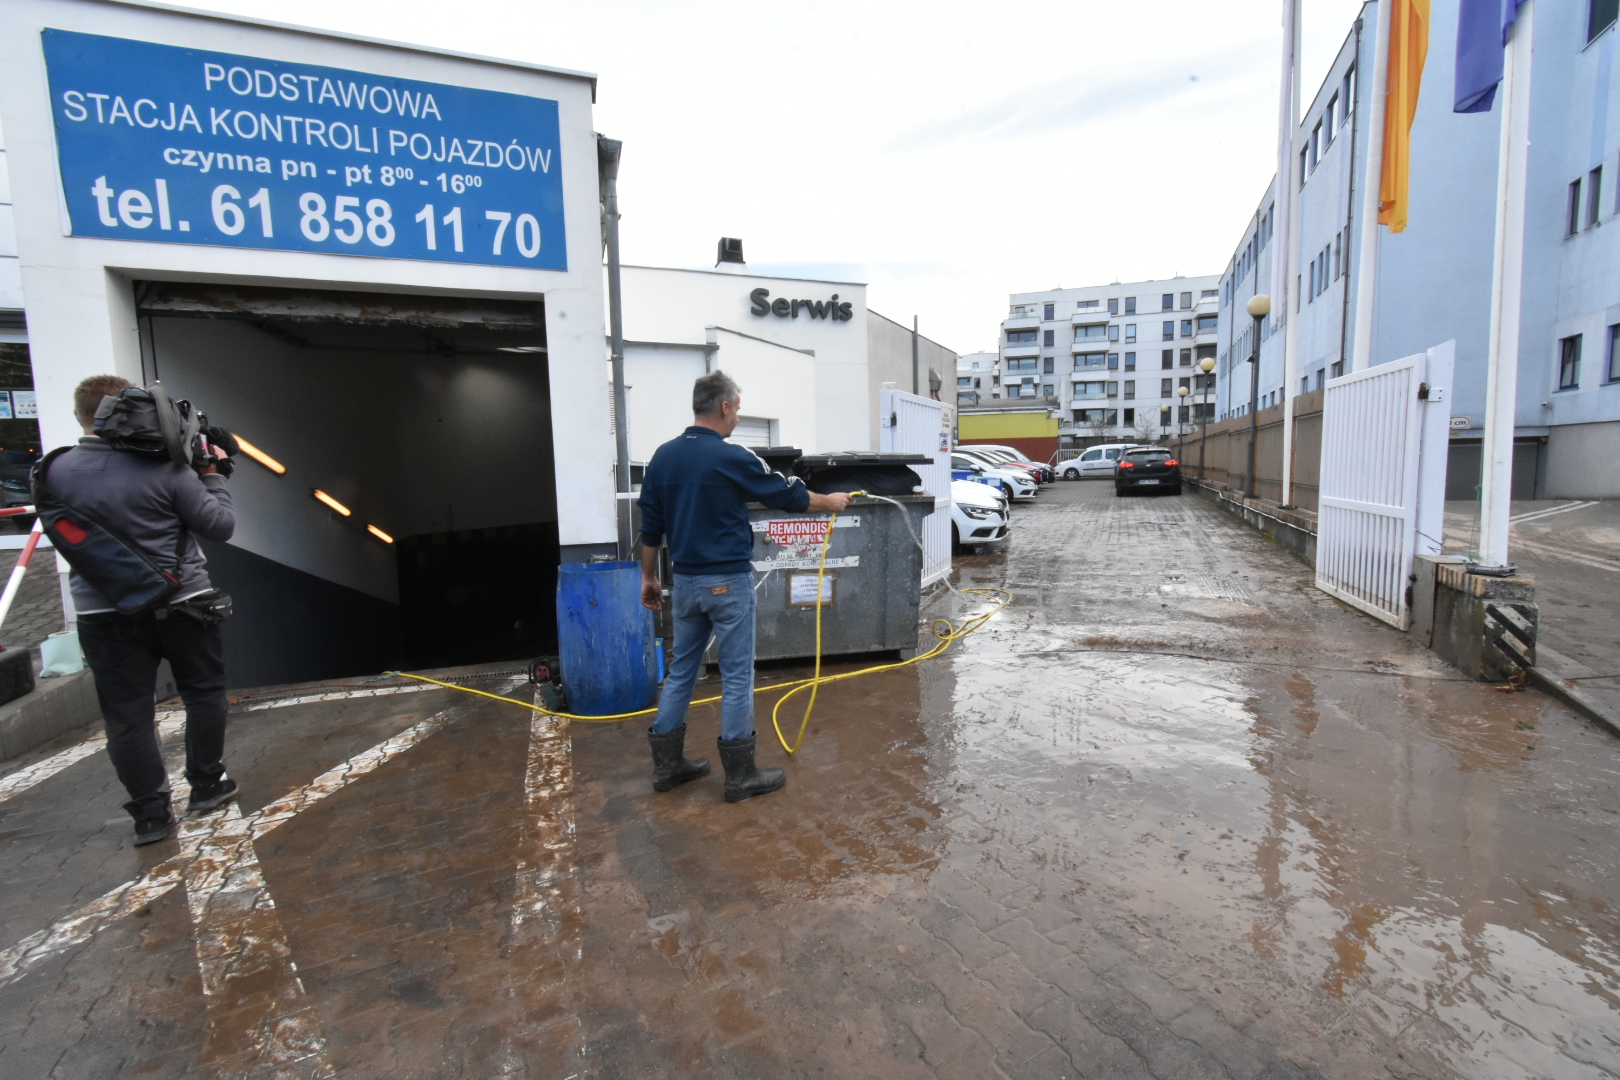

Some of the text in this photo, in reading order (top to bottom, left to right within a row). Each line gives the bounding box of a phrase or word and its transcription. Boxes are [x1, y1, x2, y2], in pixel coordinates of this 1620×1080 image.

[204, 62, 442, 121] PODSTAWOWA
[63, 90, 551, 174] STACJA KONTROLI POJAZDÓW
[163, 147, 272, 174] czynna
[281, 158, 317, 181] pn
[345, 164, 373, 187] pt
[91, 175, 541, 258] tel. 61 858 11 70
[750, 287, 853, 321] Serwis
[770, 522, 828, 535] REMONDIS
[802, 558, 839, 567] KOMUALNE
